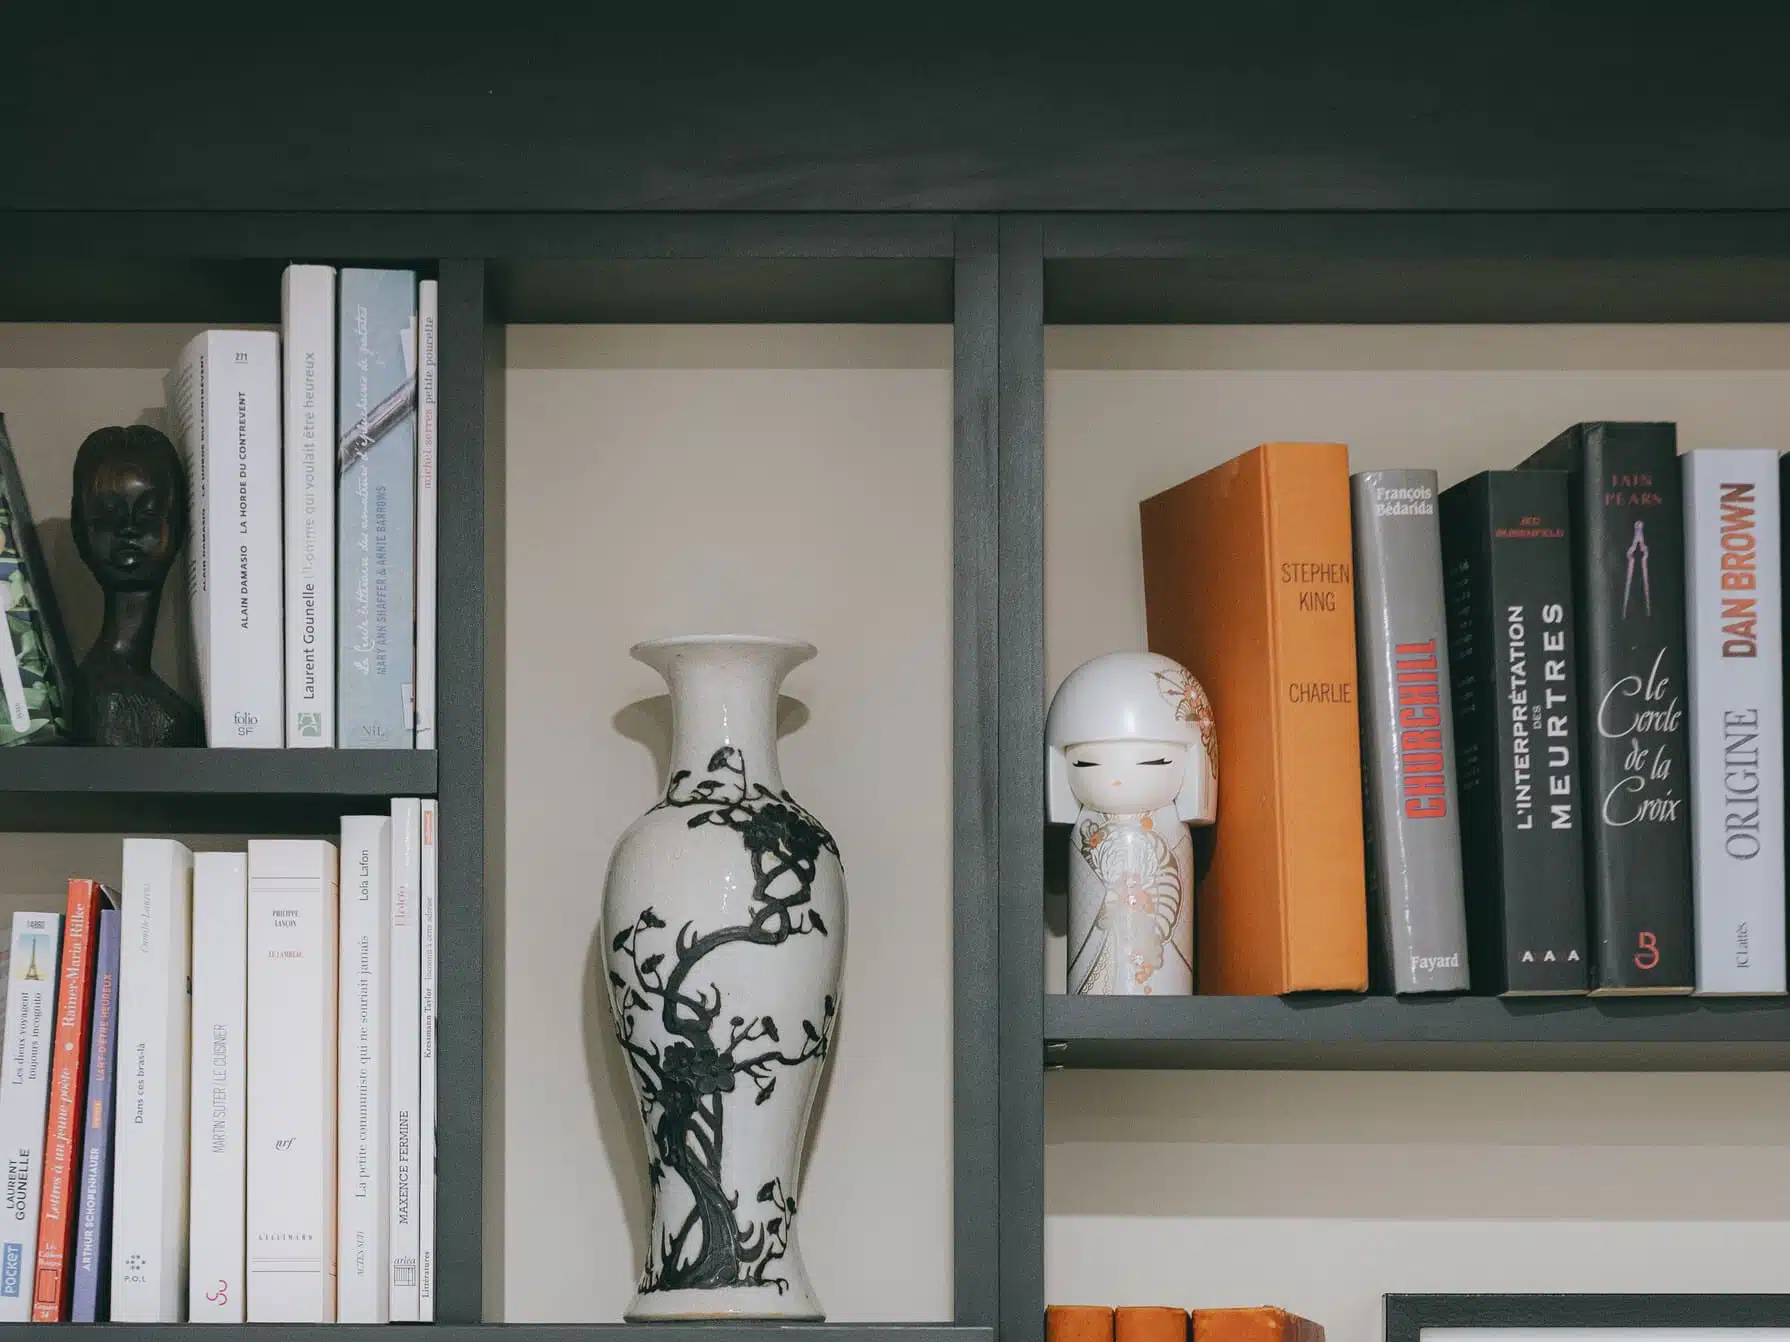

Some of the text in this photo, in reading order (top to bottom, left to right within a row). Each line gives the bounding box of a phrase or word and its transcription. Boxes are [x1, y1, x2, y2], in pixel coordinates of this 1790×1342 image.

[236, 353, 248, 361] 271
[302, 352, 315, 408] heureux
[420, 317, 437, 489] michel serres petite poucette
[302, 443, 315, 490] voulait
[238, 391, 249, 629] ALAIN DAMASIO LA HORDE DU CONTREVENT
[303, 494, 317, 514] qui
[1376, 487, 1432, 502] François
[1376, 502, 1433, 517] Bédarida
[376, 486, 387, 676] MARY ANN SHAFFER & ANNIE BARROWS
[1281, 562, 1350, 584] STEPHEN
[1720, 483, 1757, 658] DAN BROWN
[303, 584, 315, 644] Gounelle
[1300, 591, 1336, 612] KING
[303, 648, 315, 699] Laurent
[1289, 683, 1352, 704] CHARLIE
[234, 712, 259, 726] folio
[1395, 638, 1447, 820] CHURCHILL
[1508, 605, 1533, 829] L'INTERPRÉTATION
[1532, 705, 1542, 730] DES
[1542, 603, 1572, 829] MEURTRES
[1597, 676, 1682, 738] Cercle
[238, 727, 253, 736] SF
[1624, 738, 1672, 780] de la
[1602, 766, 1682, 827] Croix
[1724, 708, 1761, 860] ORIGINE
[69, 903, 85, 938] Rilke
[1411, 954, 1459, 971] Fayard
[61, 942, 81, 1028] Rainer-Maria
[98, 973, 113, 1019] HEUREUX
[424, 987, 433, 1013] Taylor
[12, 992, 30, 1086] Les dieux voyagent
[27, 992, 42, 1081] toujours incognito
[213, 1024, 228, 1067] CUISINIER
[356, 849, 372, 1198] La petite communiste qui ne souriait jamais Lola Lafon
[423, 1015, 433, 1059] Kressmann
[95, 1056, 107, 1081] L'ART
[134, 1043, 146, 1124] Dans ces bras-là
[213, 1071, 227, 1081] LE
[53, 1105, 68, 1141] jeune
[212, 1087, 227, 1118] SUTER
[54, 1143, 65, 1161] un
[212, 1121, 226, 1154] MARTIN
[275, 1137, 296, 1151] nrf
[6, 1160, 17, 1209] LAURENT
[15, 1149, 30, 1220] GOUNELLE
[50, 1165, 62, 1175] à
[86, 1147, 100, 1228] SCHOPENHAUER
[399, 1110, 409, 1225] MAXENCE FERMINE
[45, 1178, 61, 1220] Lettres
[82, 1231, 93, 1271] ARTHUR
[421, 1251, 430, 1298] Littératures
